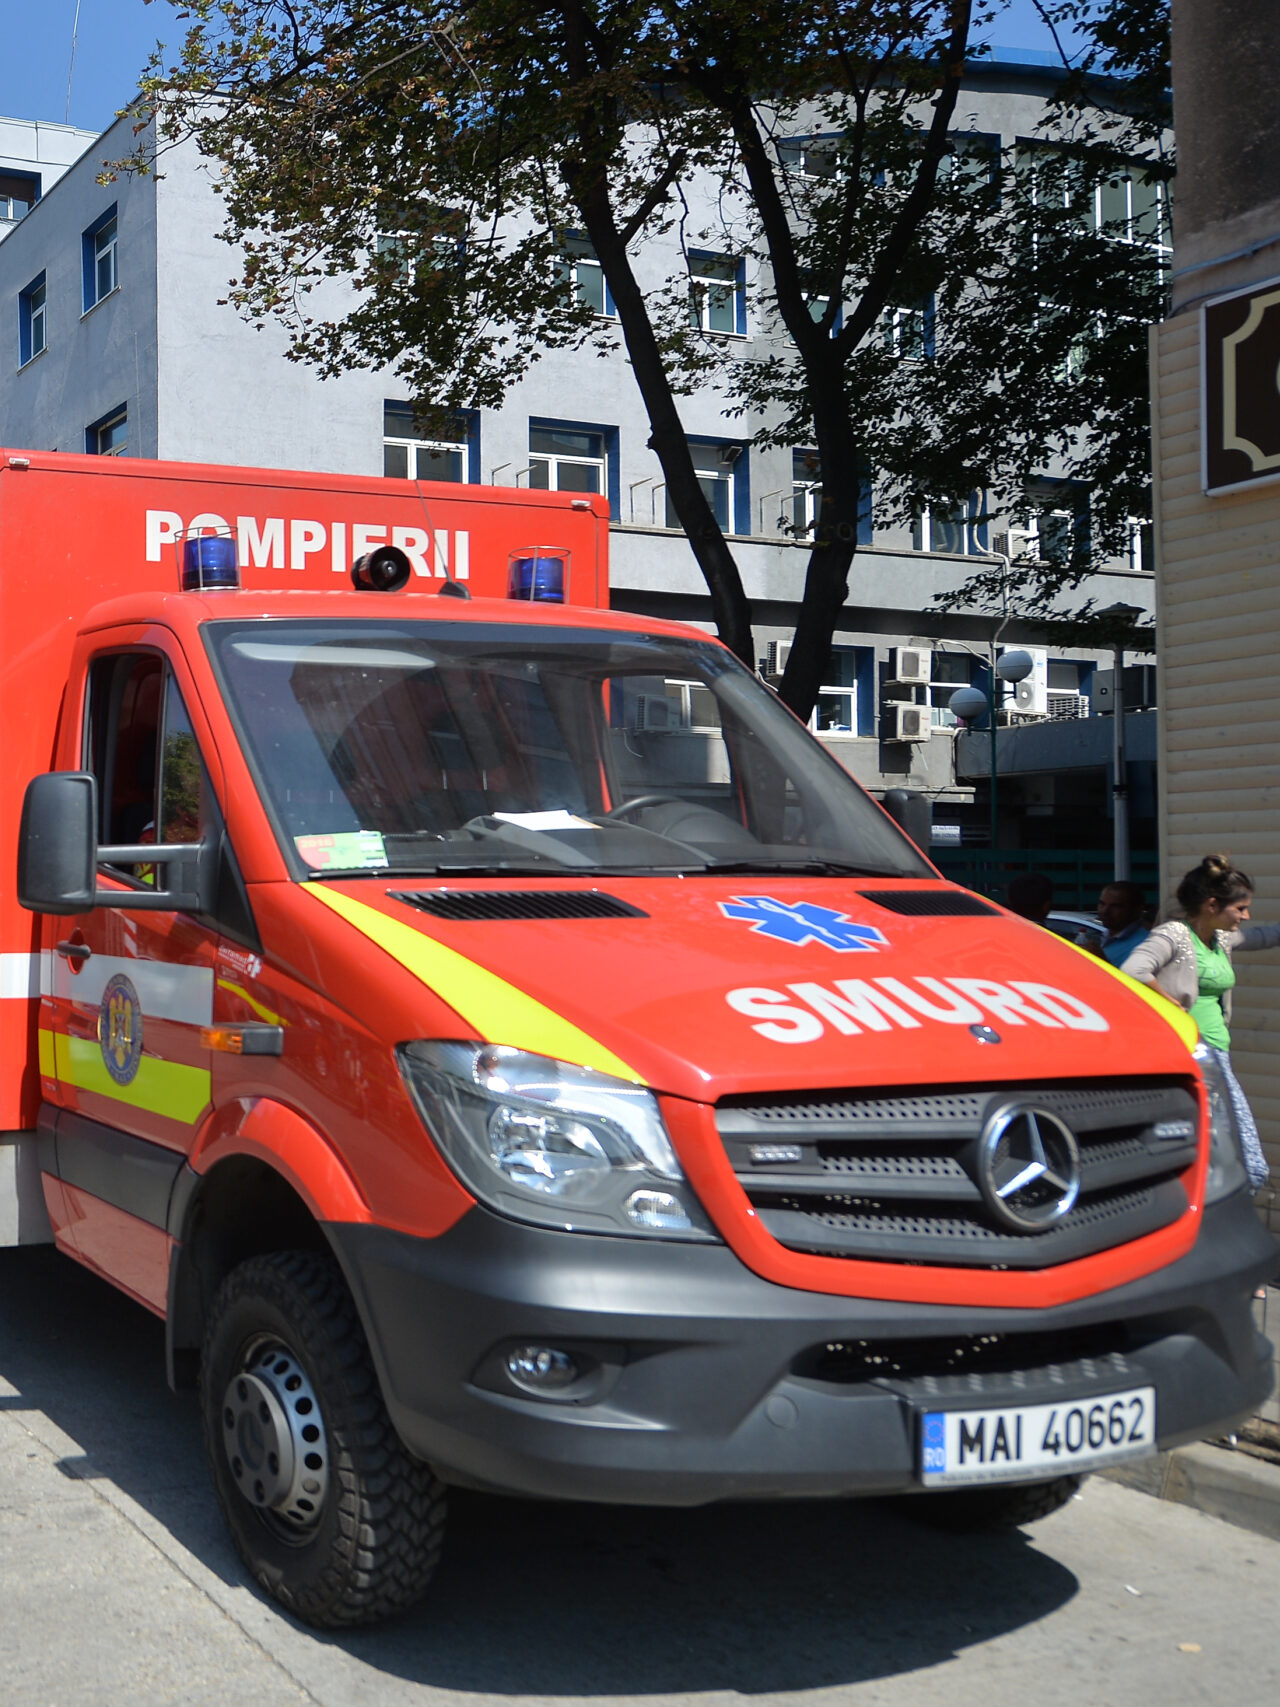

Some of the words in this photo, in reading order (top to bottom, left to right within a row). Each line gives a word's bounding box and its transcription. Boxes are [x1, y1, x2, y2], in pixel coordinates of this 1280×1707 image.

[725, 976, 1111, 1044] SMURD
[924, 1446, 945, 1469] RO
[958, 1414, 1022, 1465] MAI
[1040, 1397, 1145, 1457] 40662
